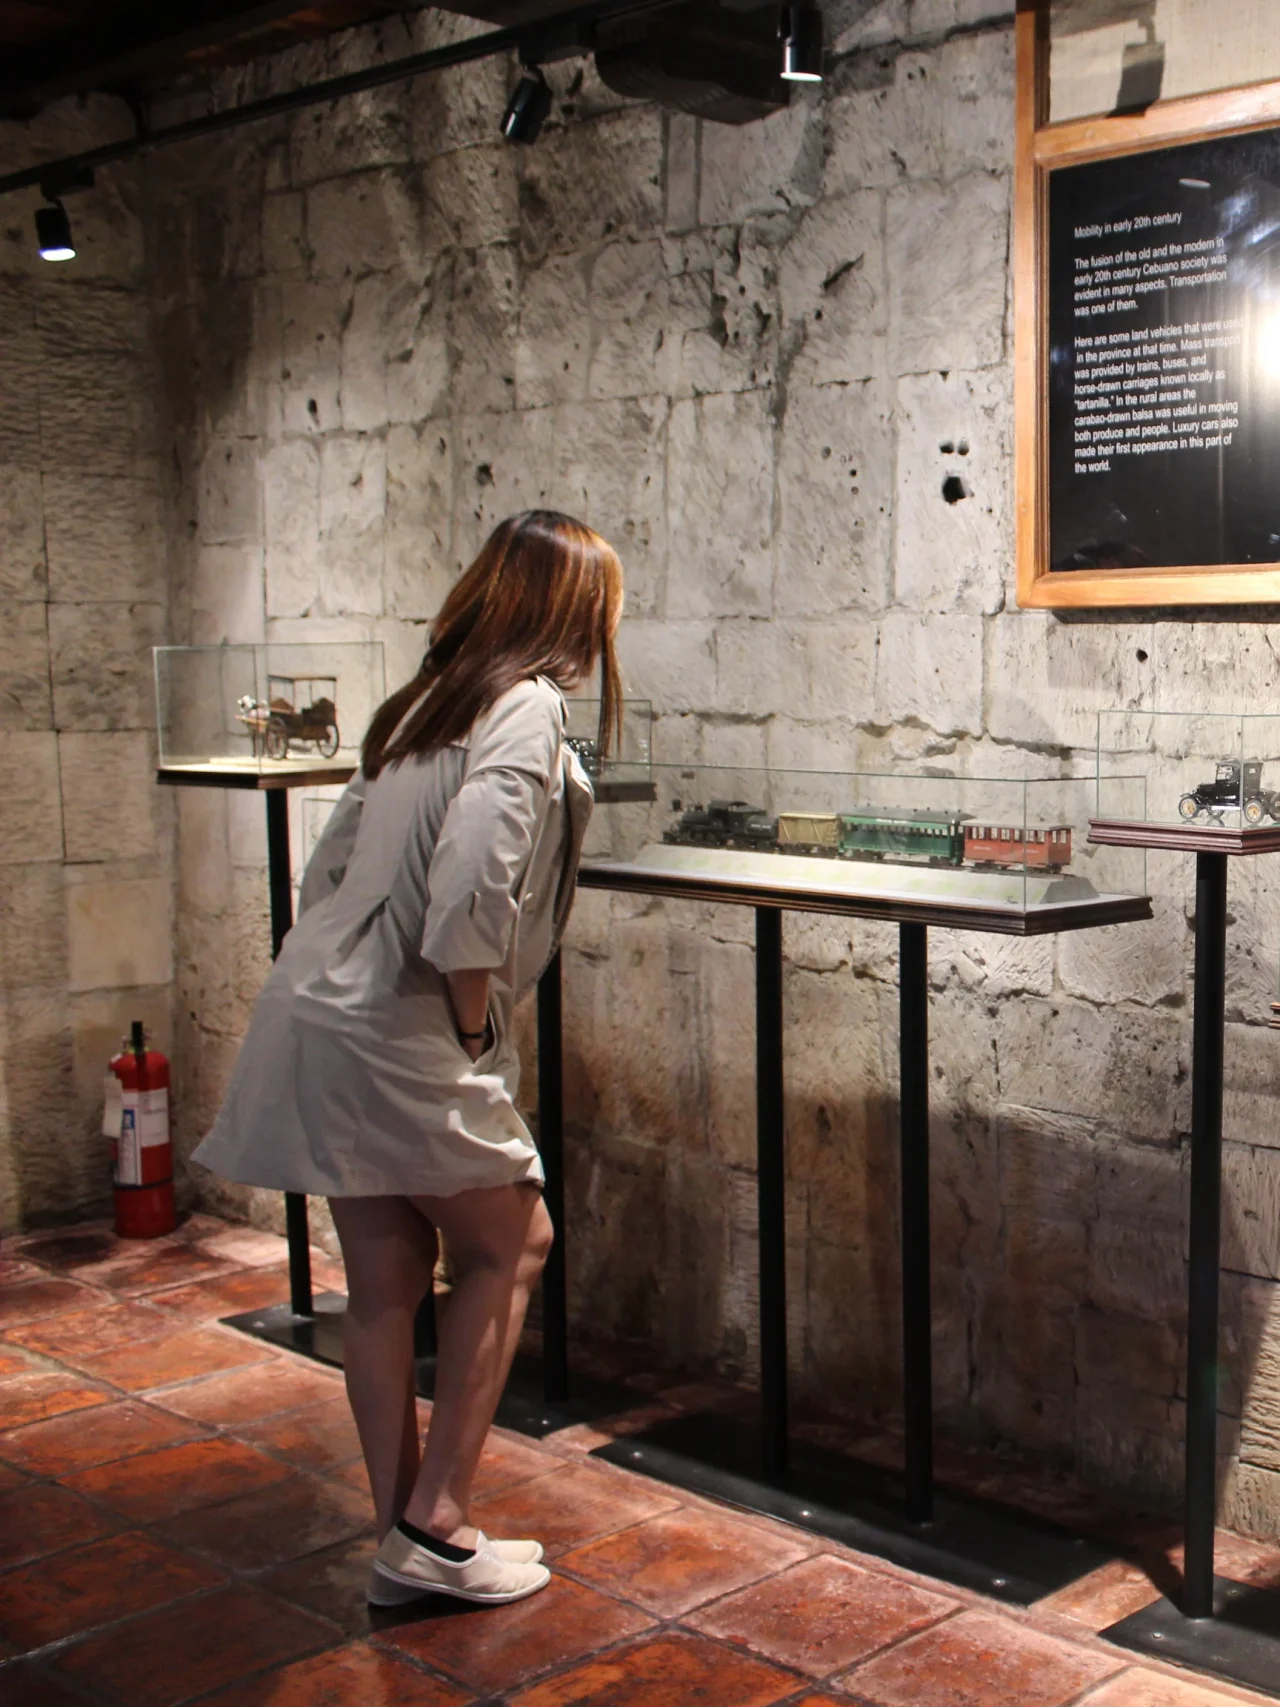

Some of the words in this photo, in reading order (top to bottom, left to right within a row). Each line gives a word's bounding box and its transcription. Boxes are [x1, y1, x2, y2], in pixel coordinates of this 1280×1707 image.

[1074, 225, 1102, 238] Mobility
[1105, 222, 1111, 233] in
[1113, 219, 1132, 232] early
[1134, 216, 1151, 228] 20th
[1153, 212, 1182, 225] century
[1075, 258, 1089, 269] The
[1091, 254, 1113, 266] fusion
[1115, 251, 1123, 262] of
[1125, 250, 1136, 262] the
[1139, 247, 1150, 259] old
[1152, 244, 1167, 257] and
[1169, 243, 1182, 254] the
[1184, 239, 1214, 252] modern
[1074, 273, 1093, 286] early
[1095, 270, 1111, 282] 20th
[1113, 267, 1140, 278] century
[1143, 261, 1178, 274] Cebuano
[1181, 257, 1208, 269] society
[1211, 254, 1227, 264] was
[1074, 287, 1101, 301] evident
[1103, 286, 1110, 297] in
[1112, 284, 1133, 295] many
[1135, 278, 1167, 293] aspects.
[1169, 270, 1226, 287] Transportation
[1074, 307, 1089, 317] was
[1091, 304, 1105, 314] one
[1107, 300, 1116, 312] of
[1117, 299, 1138, 310] them.
[1075, 336, 1092, 348] Here
[1094, 336, 1107, 345] are
[1109, 333, 1130, 344] some
[1132, 328, 1148, 341] land
[1150, 324, 1182, 339] vehicles
[1184, 322, 1200, 333] that
[1201, 320, 1221, 331] were
[1077, 352, 1083, 363] in
[1085, 351, 1097, 362] the
[1099, 348, 1131, 363] province
[1133, 346, 1140, 357] at
[1143, 343, 1158, 355] that
[1160, 342, 1178, 353] time.
[1181, 339, 1202, 350] Mass
[1074, 369, 1089, 379] was
[1091, 363, 1123, 379] provided
[1125, 362, 1135, 376] by
[1191, 353, 1206, 366] and
[1075, 381, 1121, 395] horse-drawn
[1123, 377, 1158, 390] carriages
[1160, 374, 1186, 386] known
[1188, 369, 1213, 383] locally
[1215, 370, 1225, 380] as
[1116, 395, 1123, 406] In
[1125, 394, 1137, 404] the
[1140, 391, 1157, 404] rural
[1159, 390, 1181, 401] areas
[1183, 388, 1196, 399] the
[1074, 411, 1130, 427] carabao-drawn
[1132, 409, 1153, 420] balsa
[1155, 408, 1171, 418] was
[1173, 403, 1197, 416] useful
[1199, 403, 1206, 414] in
[1208, 400, 1238, 414] moving
[1075, 430, 1091, 442] both
[1093, 428, 1123, 443] produce
[1125, 425, 1140, 437] and
[1142, 423, 1170, 438] people.
[1173, 421, 1199, 434] Luxury
[1202, 420, 1219, 430] cars
[1221, 416, 1238, 428] also
[1075, 445, 1096, 458] made
[1098, 444, 1114, 456] their
[1116, 442, 1130, 453] first
[1132, 440, 1178, 455] appearance
[1180, 437, 1187, 448] in
[1189, 436, 1203, 448] this
[1206, 435, 1221, 449] part
[1224, 433, 1232, 444] of
[1075, 462, 1087, 473] the
[1088, 460, 1111, 471] world.
